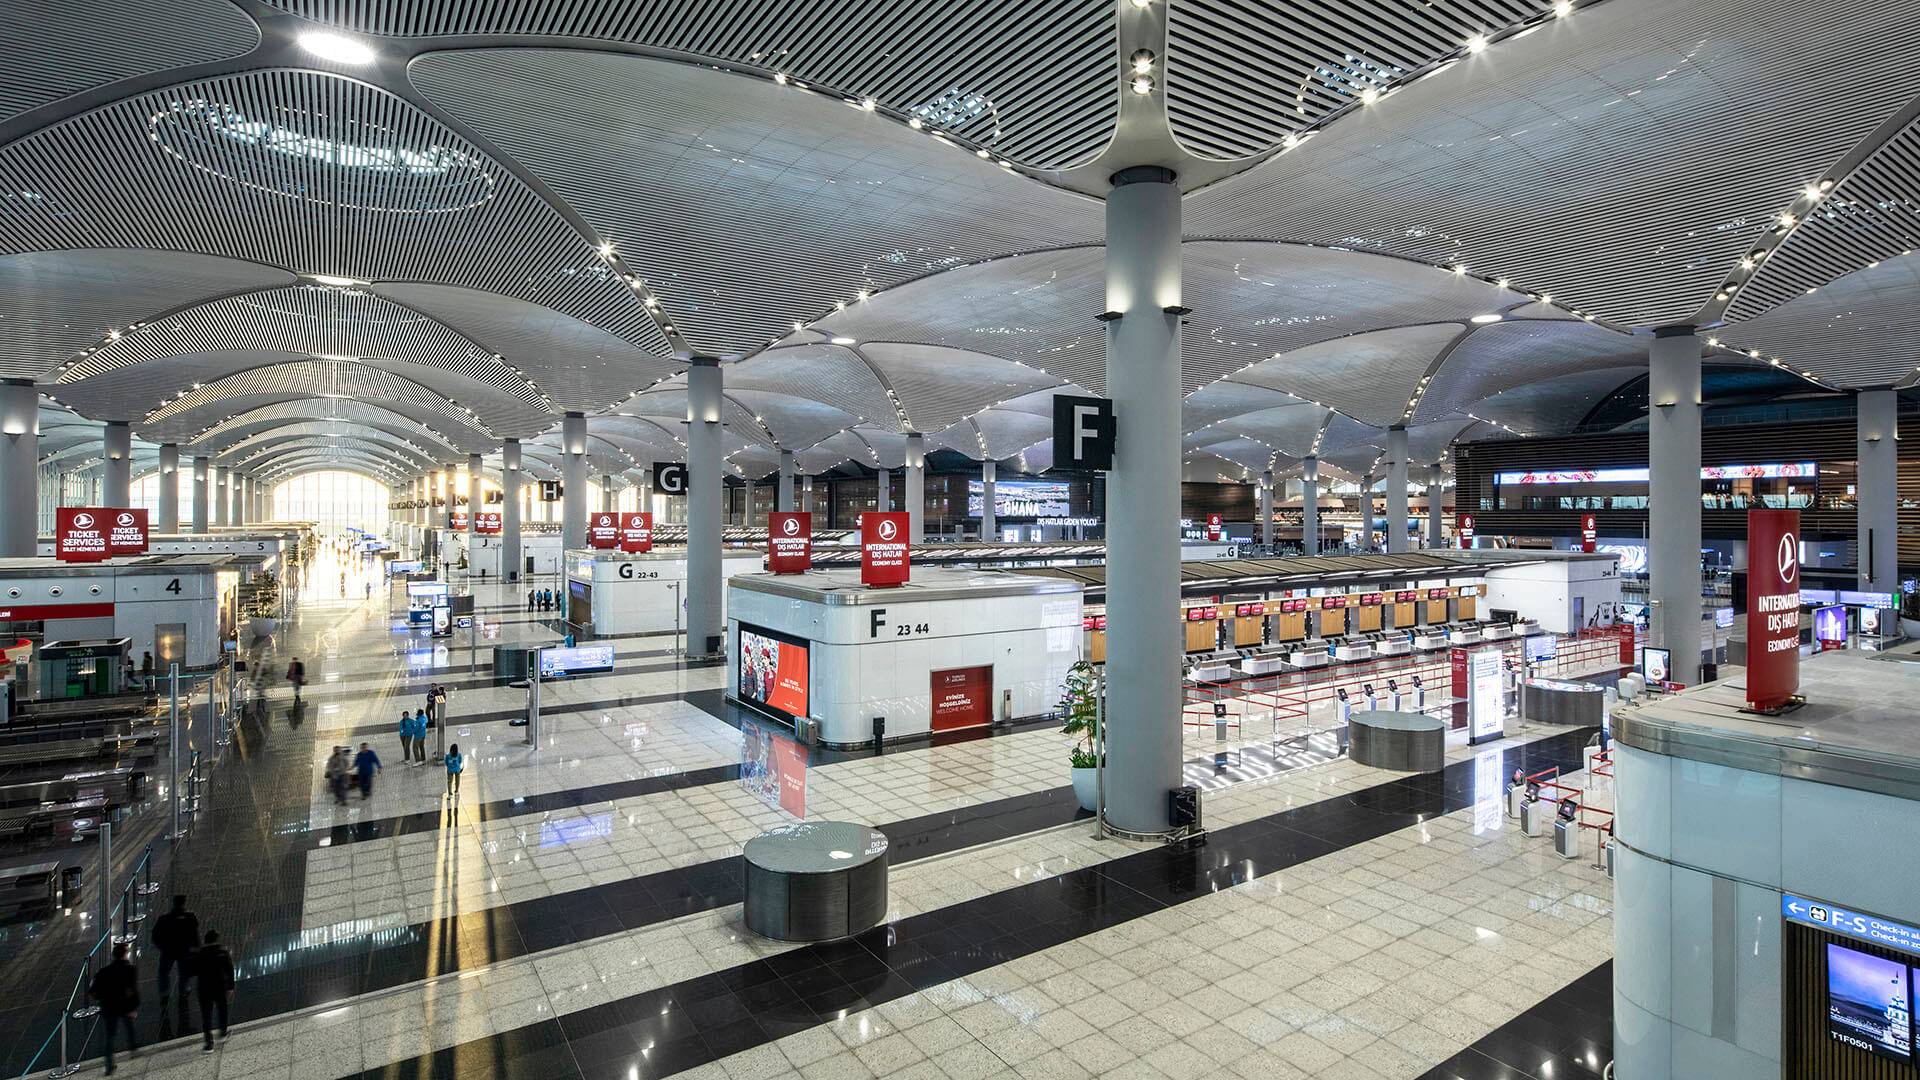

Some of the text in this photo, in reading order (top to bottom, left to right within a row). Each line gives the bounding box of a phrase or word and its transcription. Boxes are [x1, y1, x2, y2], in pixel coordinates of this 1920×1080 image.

[1074, 405, 1099, 460] F
[660, 466, 681, 491] G
[490, 491, 497, 503] J
[543, 483, 557, 499] H
[418, 500, 426, 508] M
[456, 495, 463, 505] K
[1080, 517, 1097, 526] YOLCU
[68, 530, 99, 538] TICKET
[452, 533, 458, 541] K
[62, 538, 105, 546] SERVICES
[258, 542, 264, 550] 5
[482, 539, 488, 547] J
[865, 543, 907, 551] INTERNATIONAL
[871, 550, 903, 559] DIŞ HATLAR
[1228, 547, 1234, 557] G
[619, 563, 658, 579] G 22-43
[1613, 561, 1618, 577] F
[165, 578, 182, 595] 4
[870, 609, 929, 638] F 23 44
[1767, 613, 1781, 634] DIŞ
[936, 706, 960, 715] WELCOME
[1831, 910, 1867, 934] F-S
[1870, 921, 1909, 936] Check-in
[1870, 930, 1909, 945] Check-in
[1830, 1030, 1873, 1052] T1F0501
